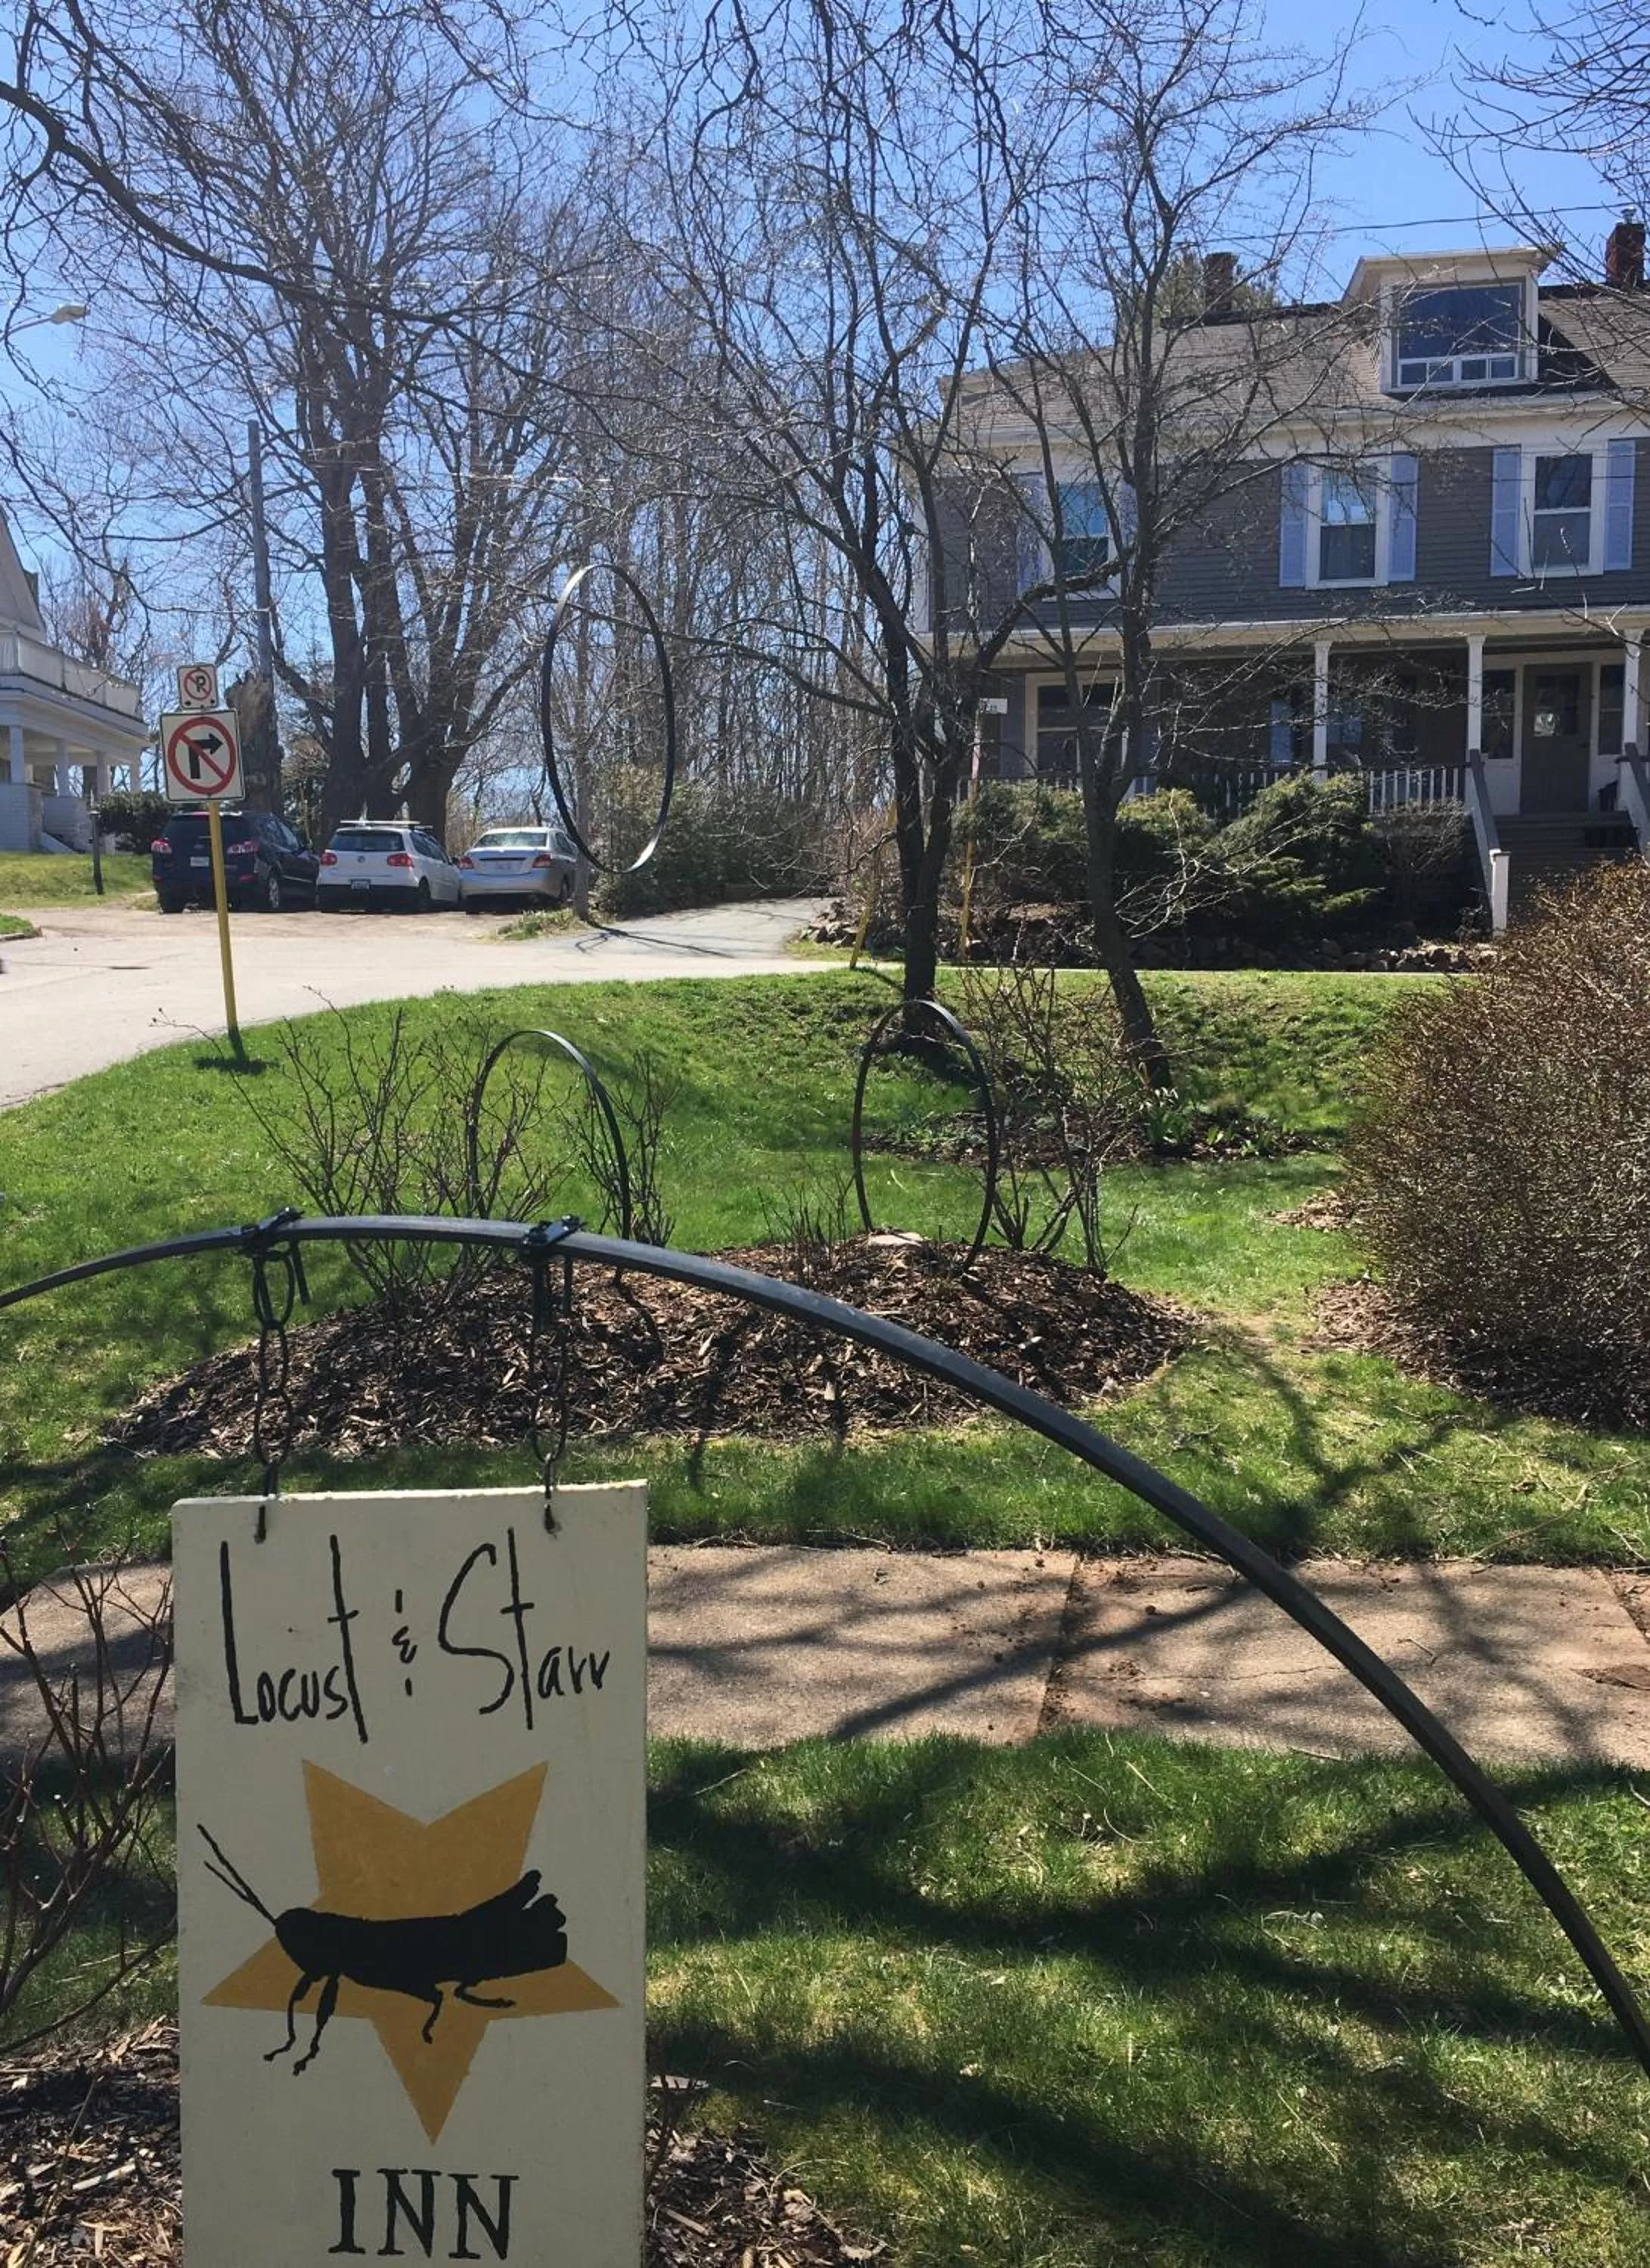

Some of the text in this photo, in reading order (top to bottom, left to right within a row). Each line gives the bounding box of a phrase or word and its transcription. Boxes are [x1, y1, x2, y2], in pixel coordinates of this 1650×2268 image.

[219, 1534, 368, 1744] Locust
[437, 1527, 611, 1731] Starr
[327, 2167, 520, 2261] INN
